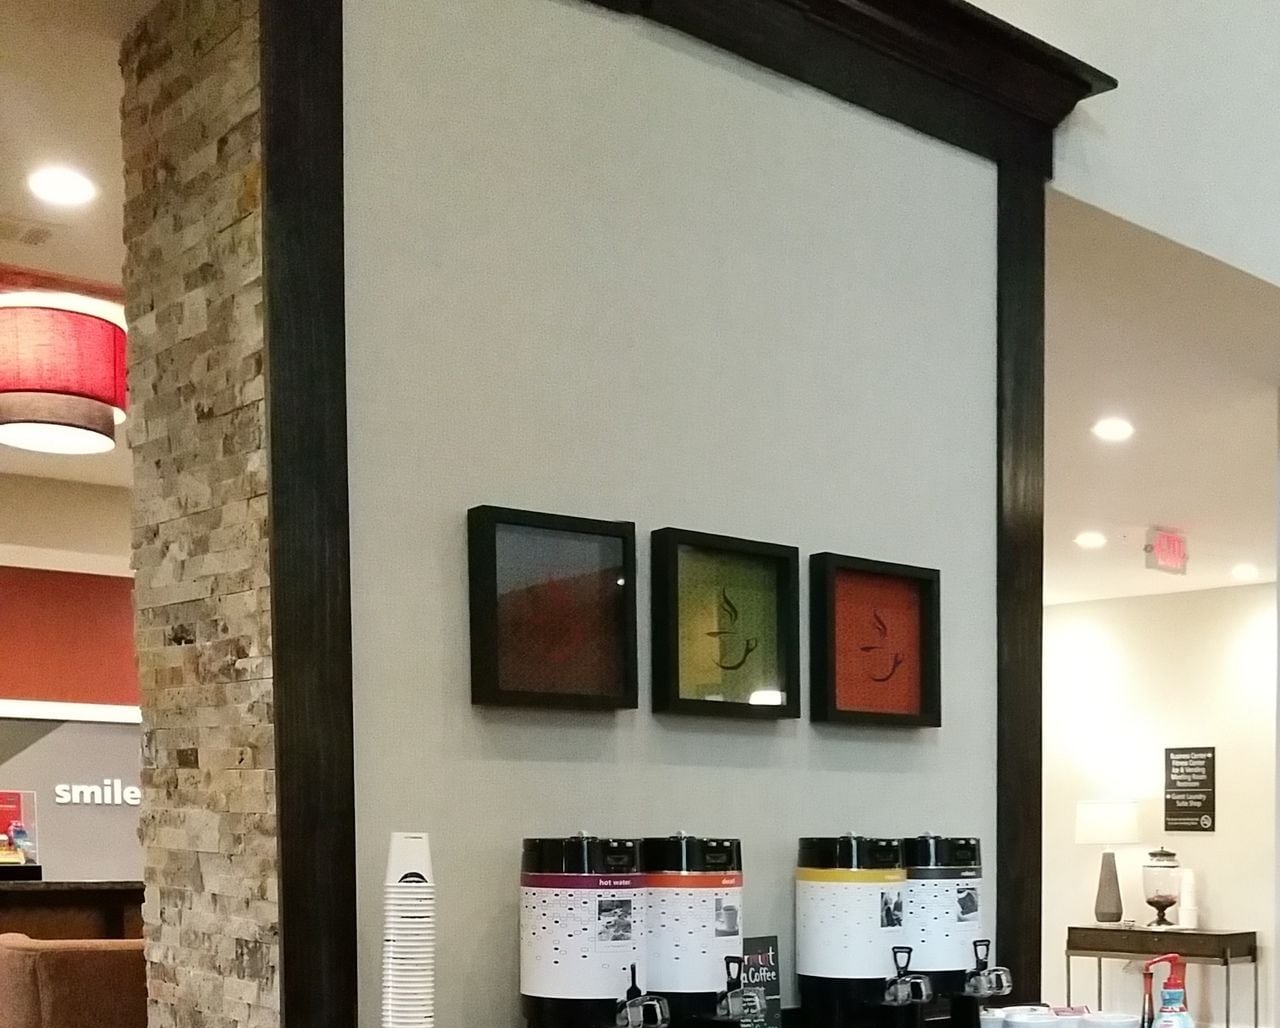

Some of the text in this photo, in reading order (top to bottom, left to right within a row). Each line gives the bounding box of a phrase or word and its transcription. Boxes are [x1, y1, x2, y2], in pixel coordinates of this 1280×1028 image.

[54, 779, 141, 806] smile
[599, 878, 611, 886] hot
[748, 967, 777, 984] Coffee
